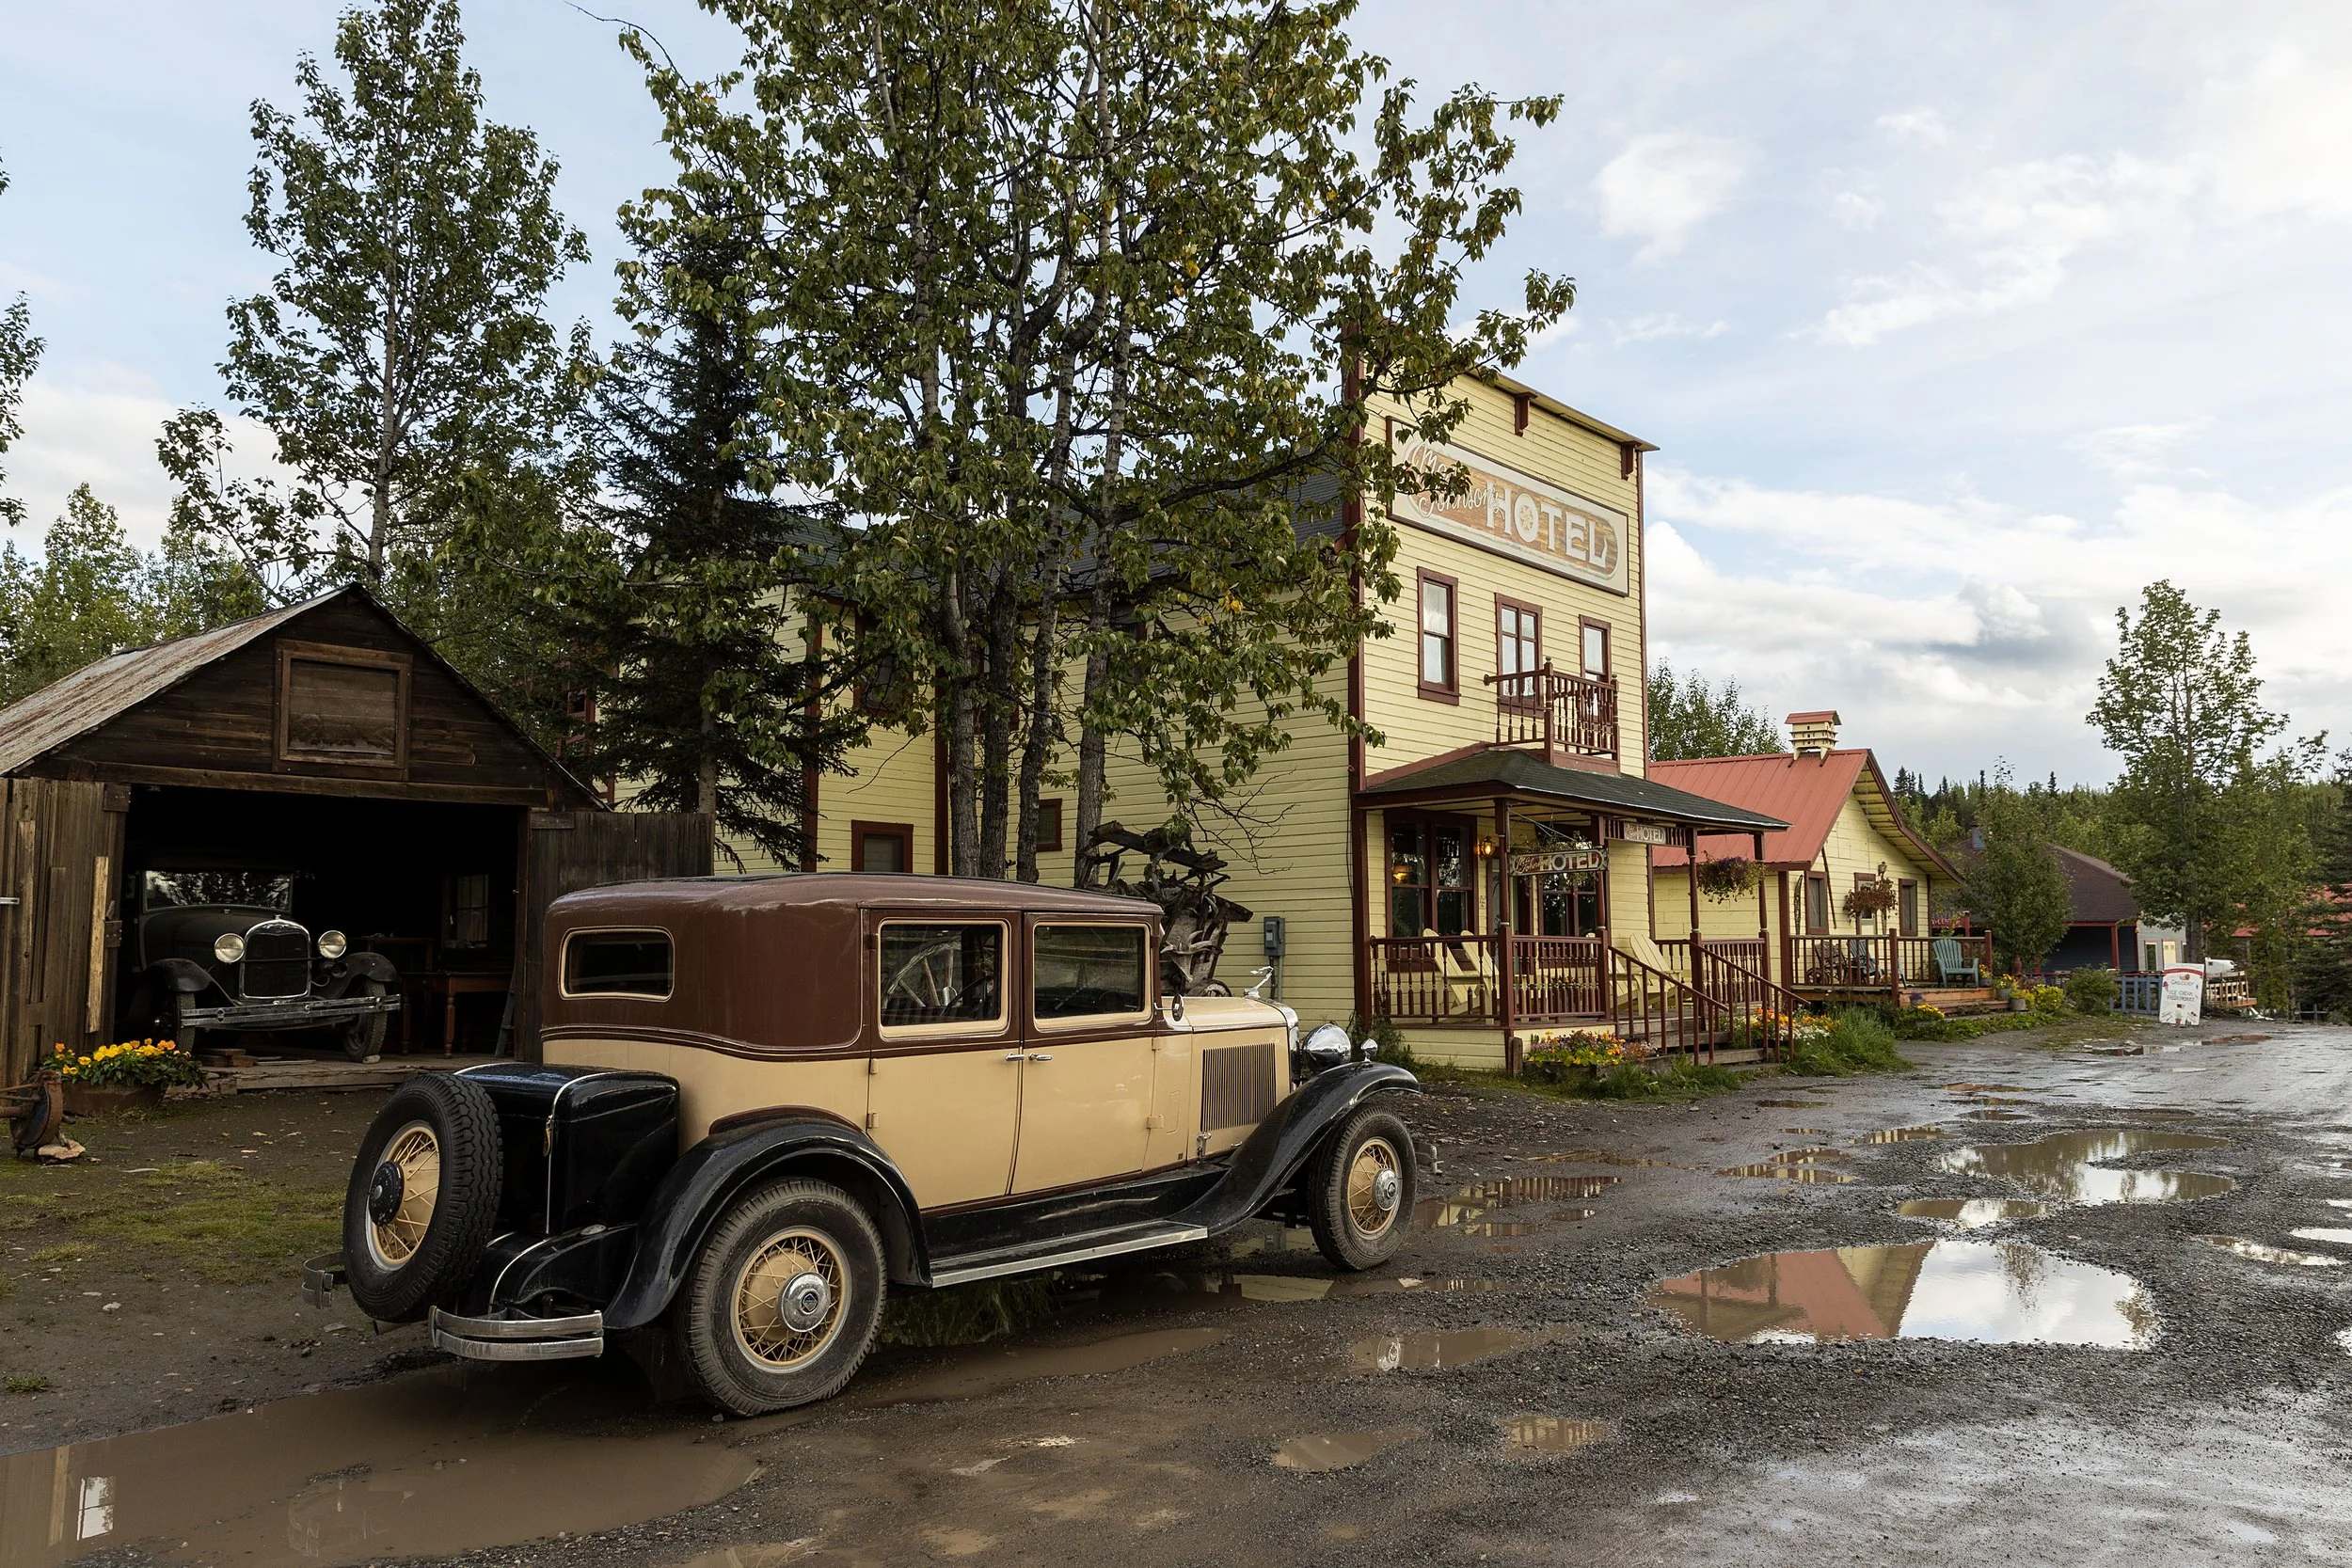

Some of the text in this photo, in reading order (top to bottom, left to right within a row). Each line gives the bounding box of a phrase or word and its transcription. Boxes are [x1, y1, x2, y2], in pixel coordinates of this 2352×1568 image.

[1486, 481, 1607, 569] HOTEL
[1637, 826, 1663, 843] HOTEL
[1539, 852, 1600, 872] HOTEL
